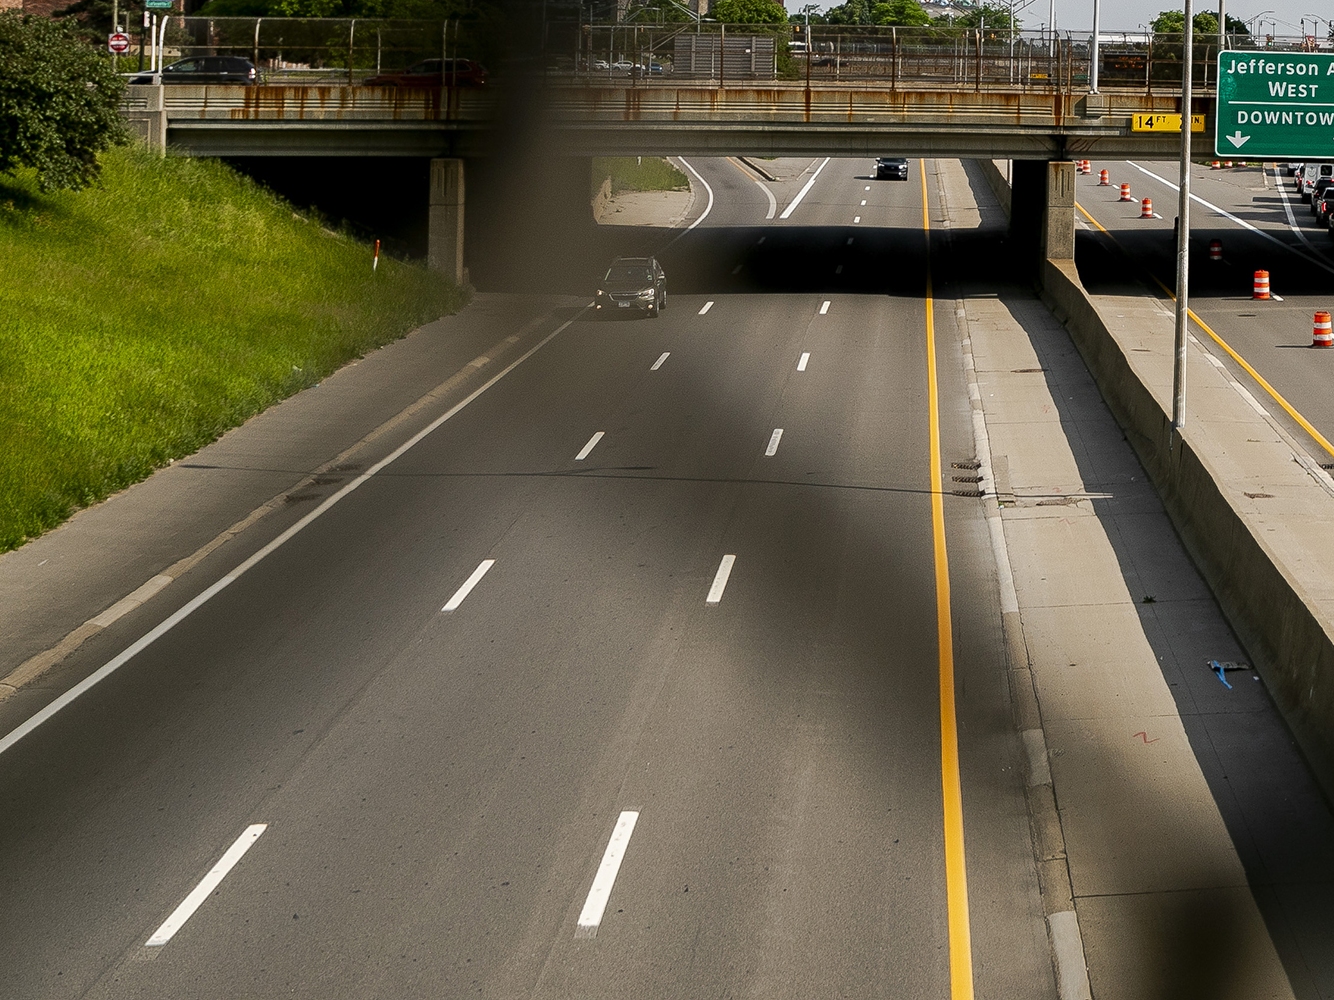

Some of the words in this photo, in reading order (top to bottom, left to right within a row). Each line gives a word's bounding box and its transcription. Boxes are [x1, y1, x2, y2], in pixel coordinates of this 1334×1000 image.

[1227, 59, 1319, 76] Jefferson
[1268, 81, 1319, 98] WEST
[1138, 115, 1154, 129] 14
